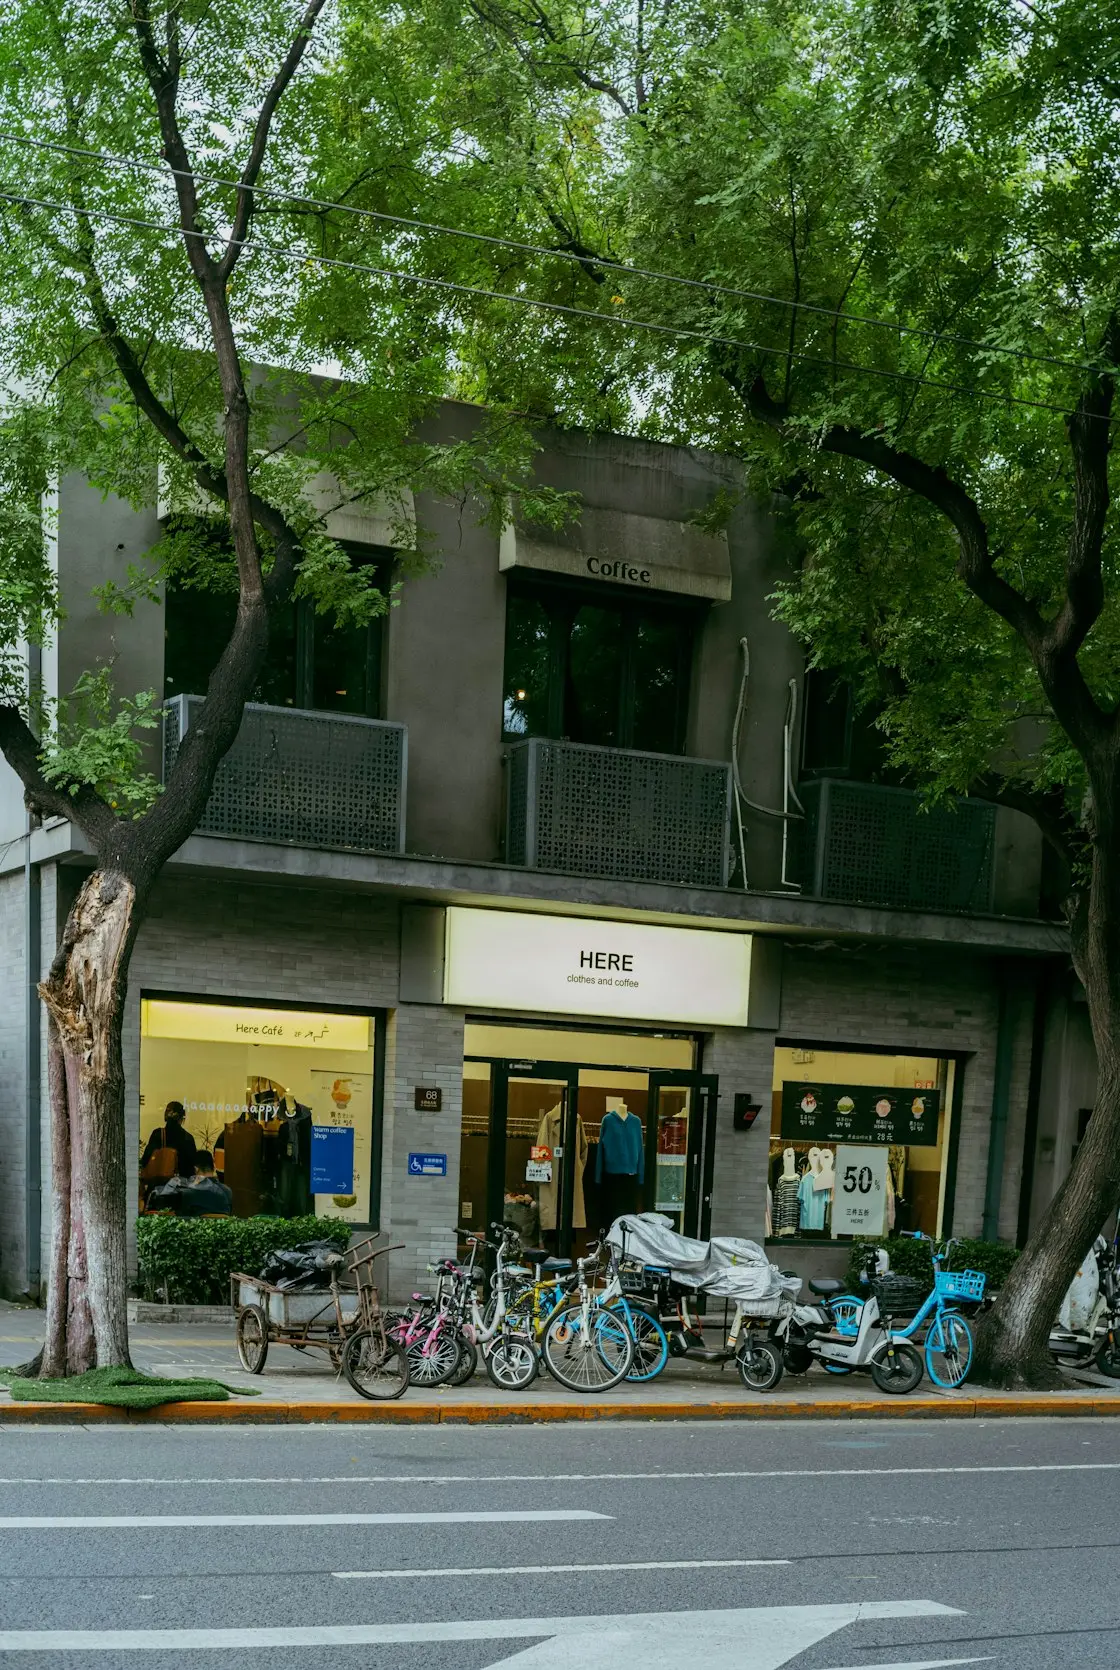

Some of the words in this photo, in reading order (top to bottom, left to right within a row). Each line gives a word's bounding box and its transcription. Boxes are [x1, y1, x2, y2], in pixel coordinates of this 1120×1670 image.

[587, 557, 651, 583] Coffee
[580, 951, 633, 971] HERE
[567, 974, 596, 985] clothes
[598, 978, 612, 986] and
[614, 979, 639, 988] coffee
[236, 1024, 259, 1034] Here
[262, 1025, 283, 1036] Café
[426, 1090, 437, 1100] 68
